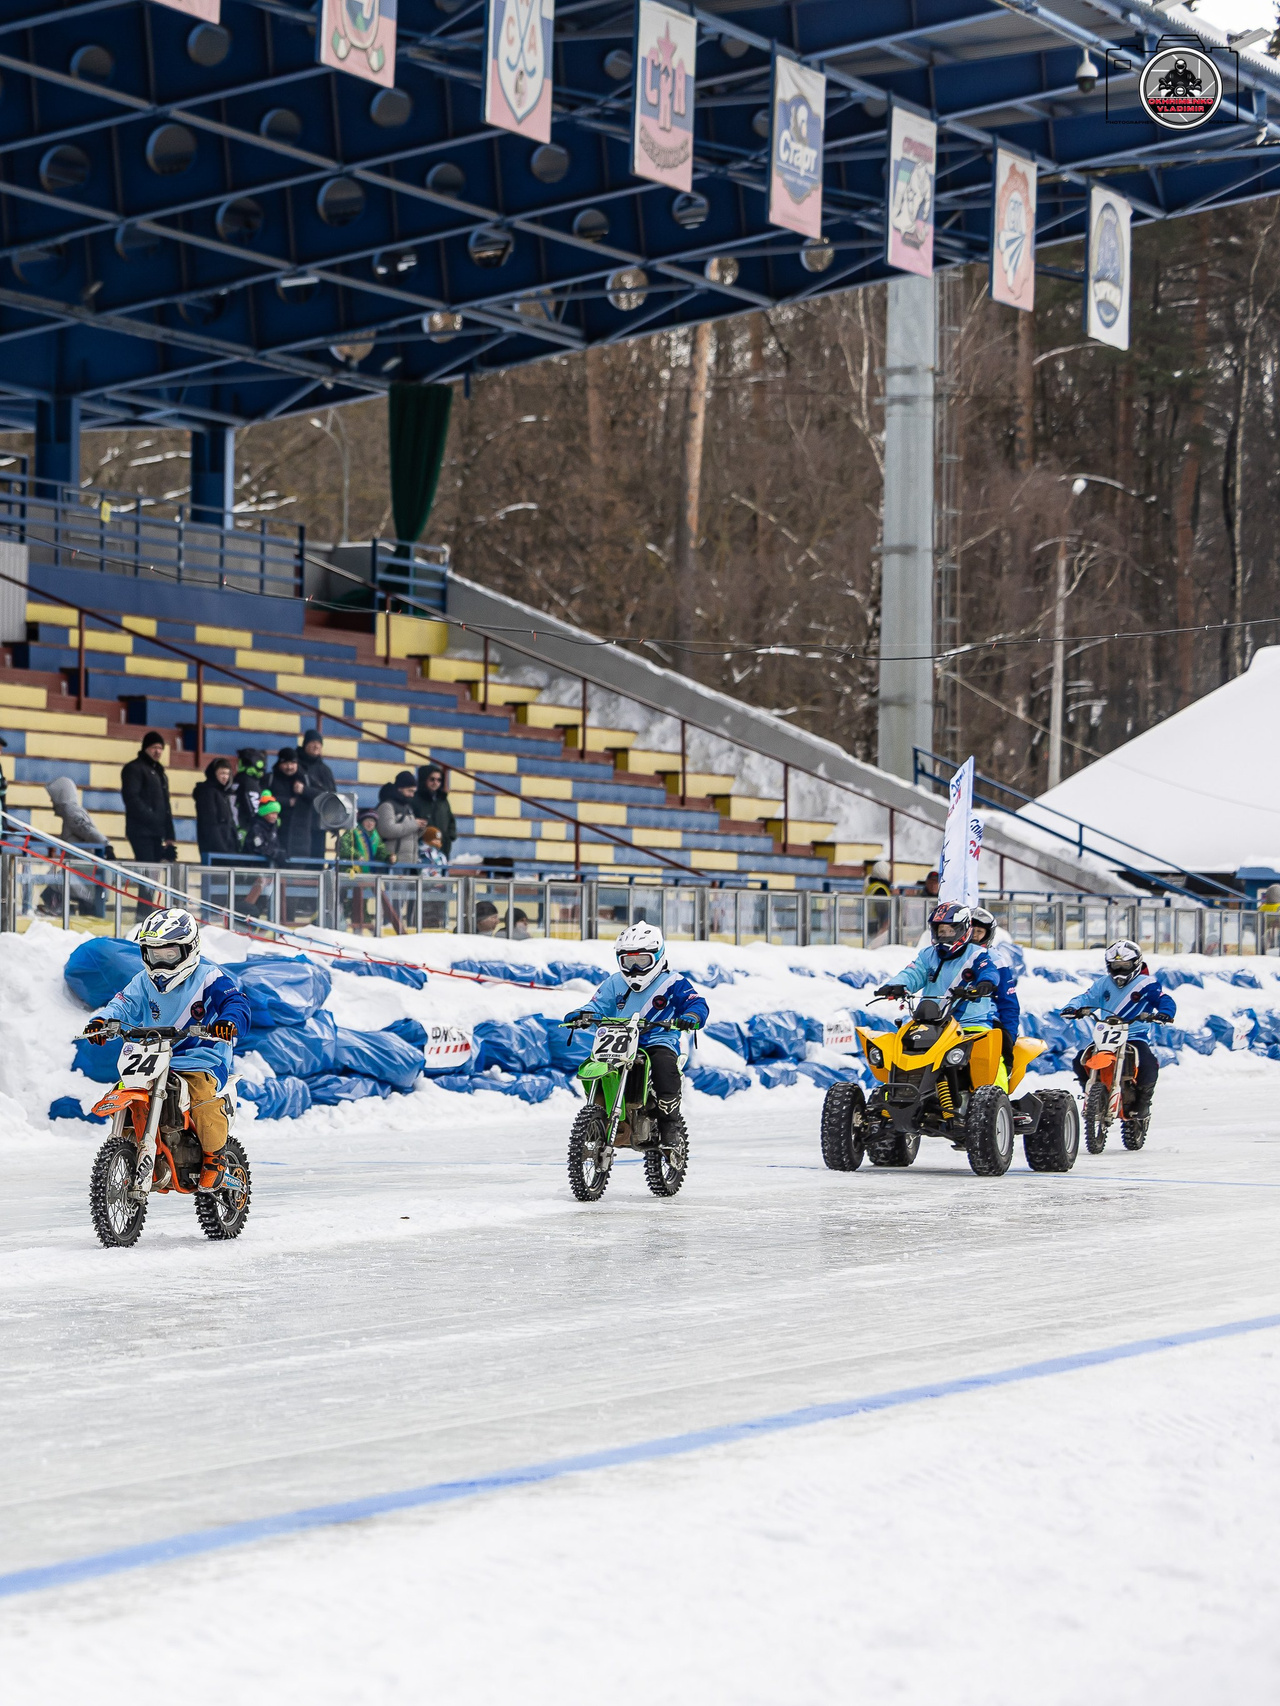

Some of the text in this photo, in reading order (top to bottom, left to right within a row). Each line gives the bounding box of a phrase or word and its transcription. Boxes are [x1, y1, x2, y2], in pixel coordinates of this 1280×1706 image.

[779, 129, 818, 177] Старт
[595, 1034, 629, 1054] 28
[1101, 1031, 1122, 1045] 12
[122, 1053, 159, 1076] 24
